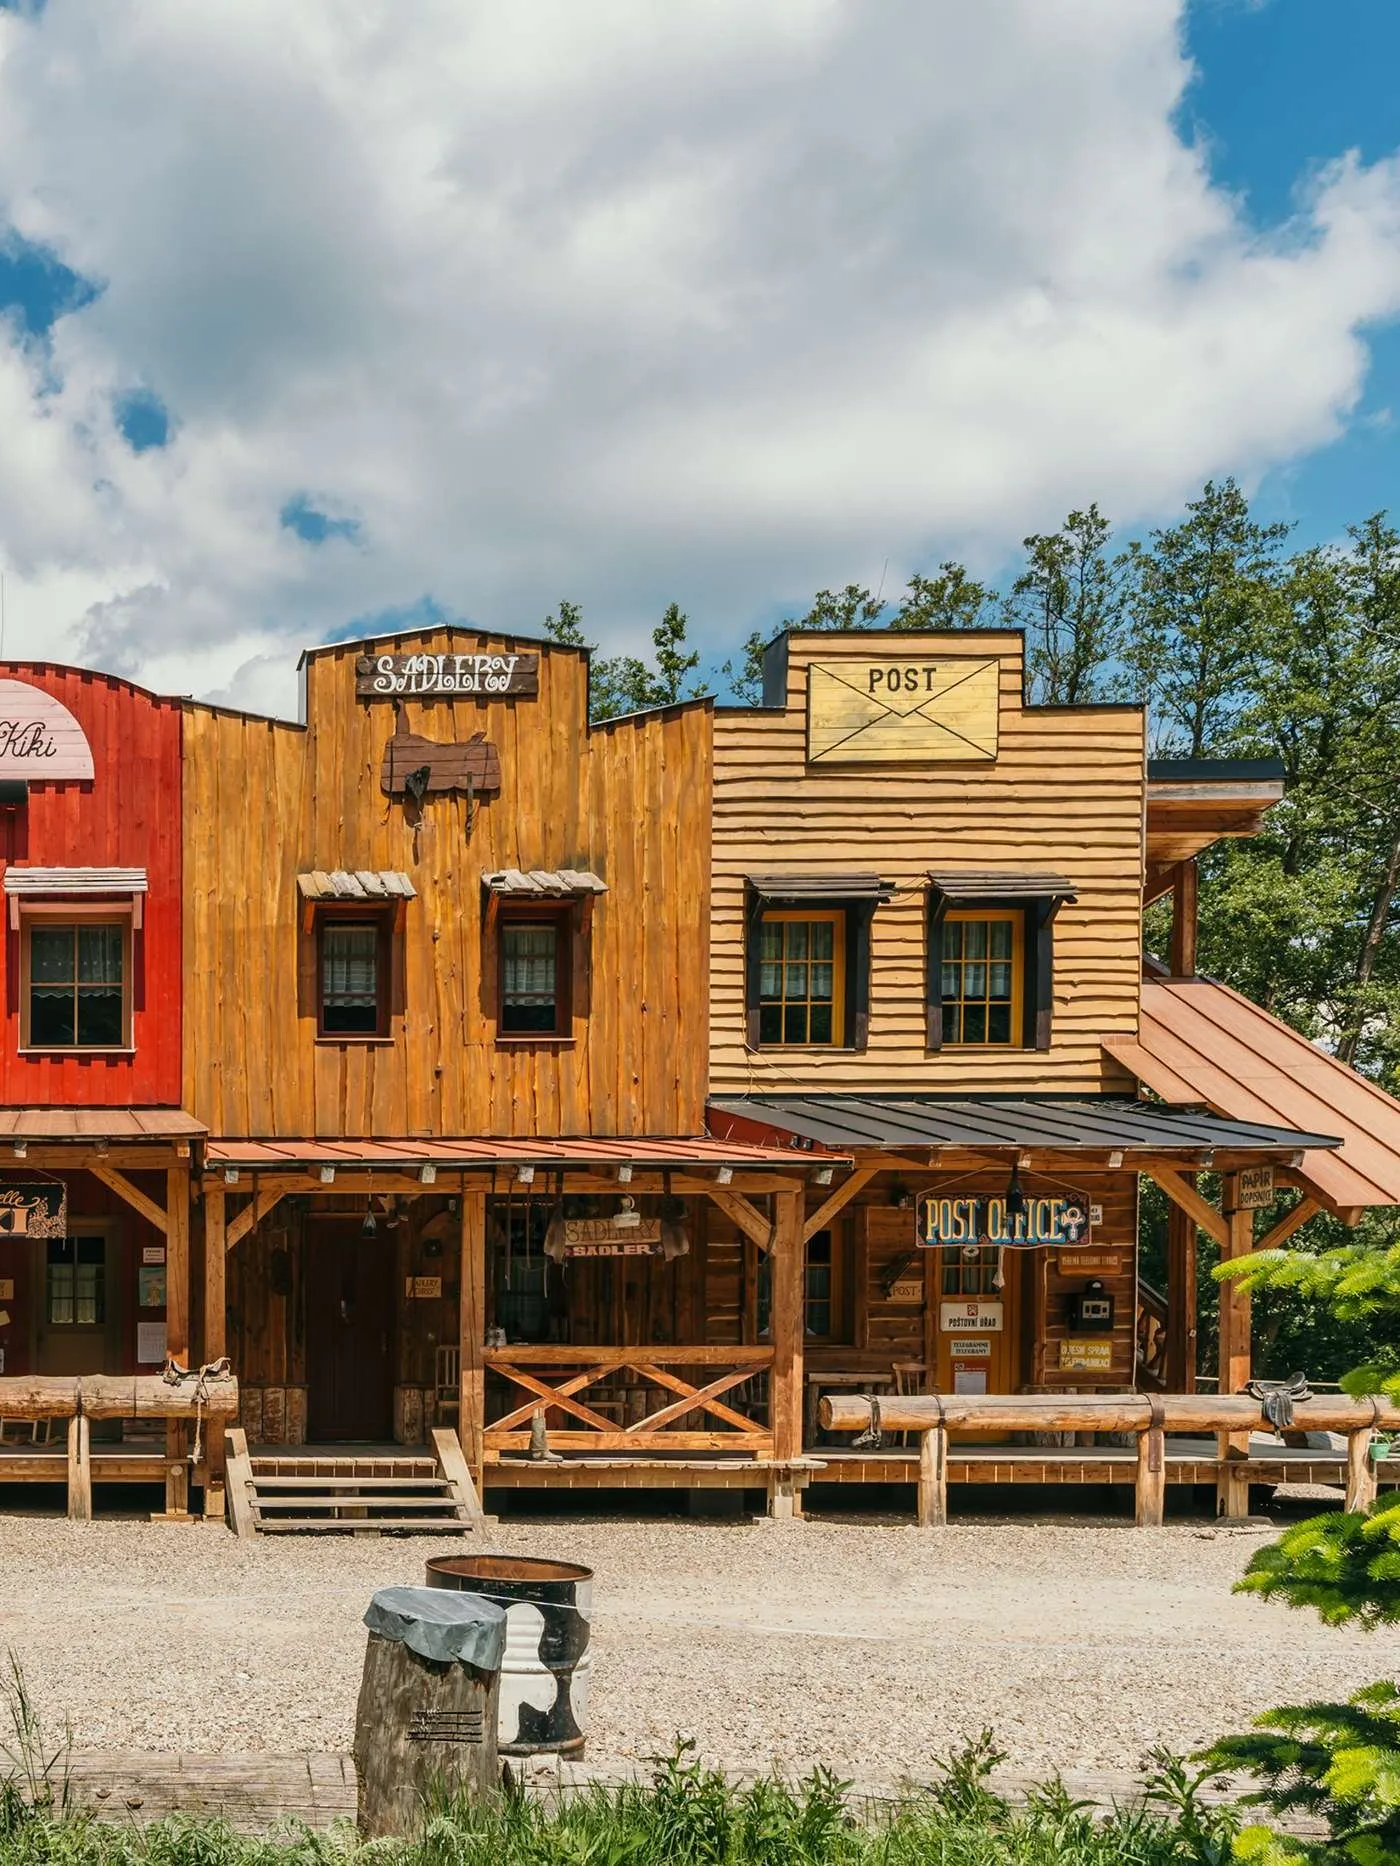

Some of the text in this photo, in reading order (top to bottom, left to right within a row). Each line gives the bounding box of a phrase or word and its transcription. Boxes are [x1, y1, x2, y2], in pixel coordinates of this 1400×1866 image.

[374, 654, 519, 693] SADLERY
[868, 667, 937, 693] POST
[925, 1199, 980, 1243] POST
[573, 1244, 656, 1256] SADLER
[893, 1286, 918, 1297] POST
[949, 1316, 978, 1327] POŠTOVNÍ
